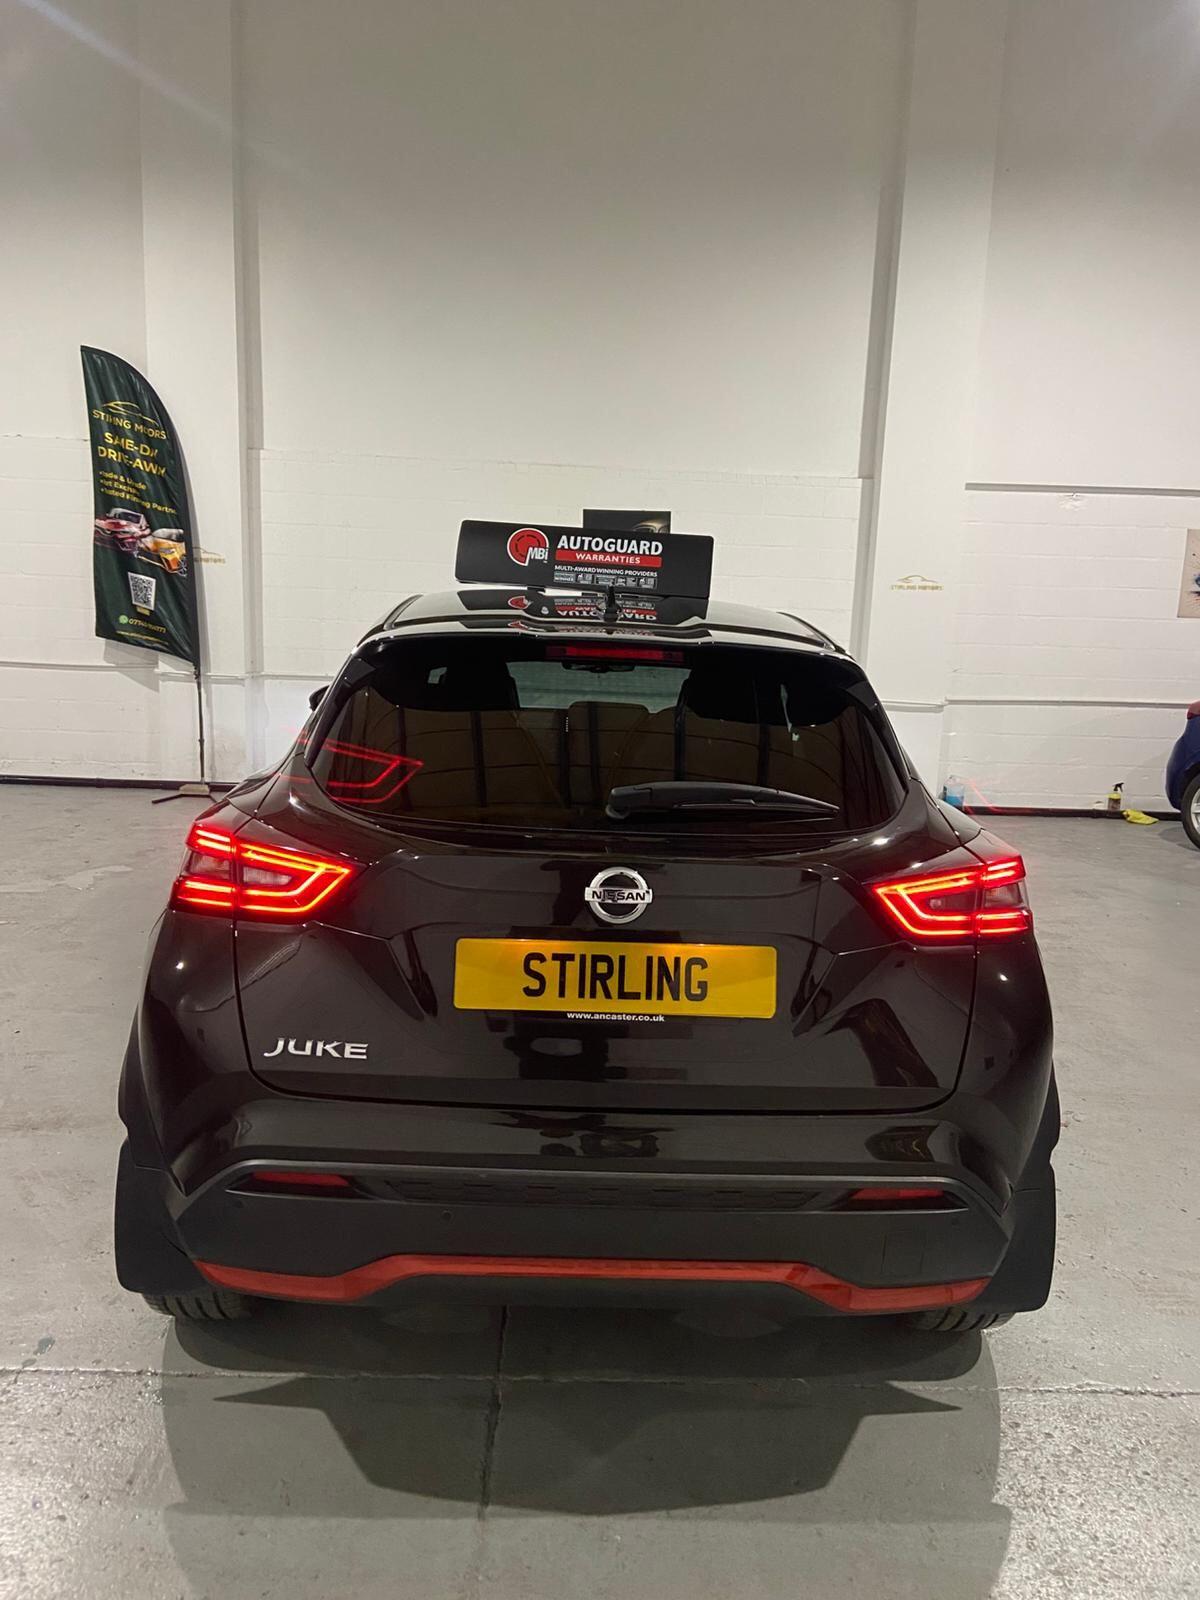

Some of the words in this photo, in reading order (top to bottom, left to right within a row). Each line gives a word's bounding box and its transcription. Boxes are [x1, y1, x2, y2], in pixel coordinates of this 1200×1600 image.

[557, 535, 663, 556] AUTOGUARD
[576, 553, 641, 565] WARRANTIES
[591, 890, 646, 901] NISSAN
[522, 952, 709, 1002] STIRLING
[566, 1012, 665, 1022] www.ancaster.co.uk
[263, 1038, 369, 1060] JUKE
